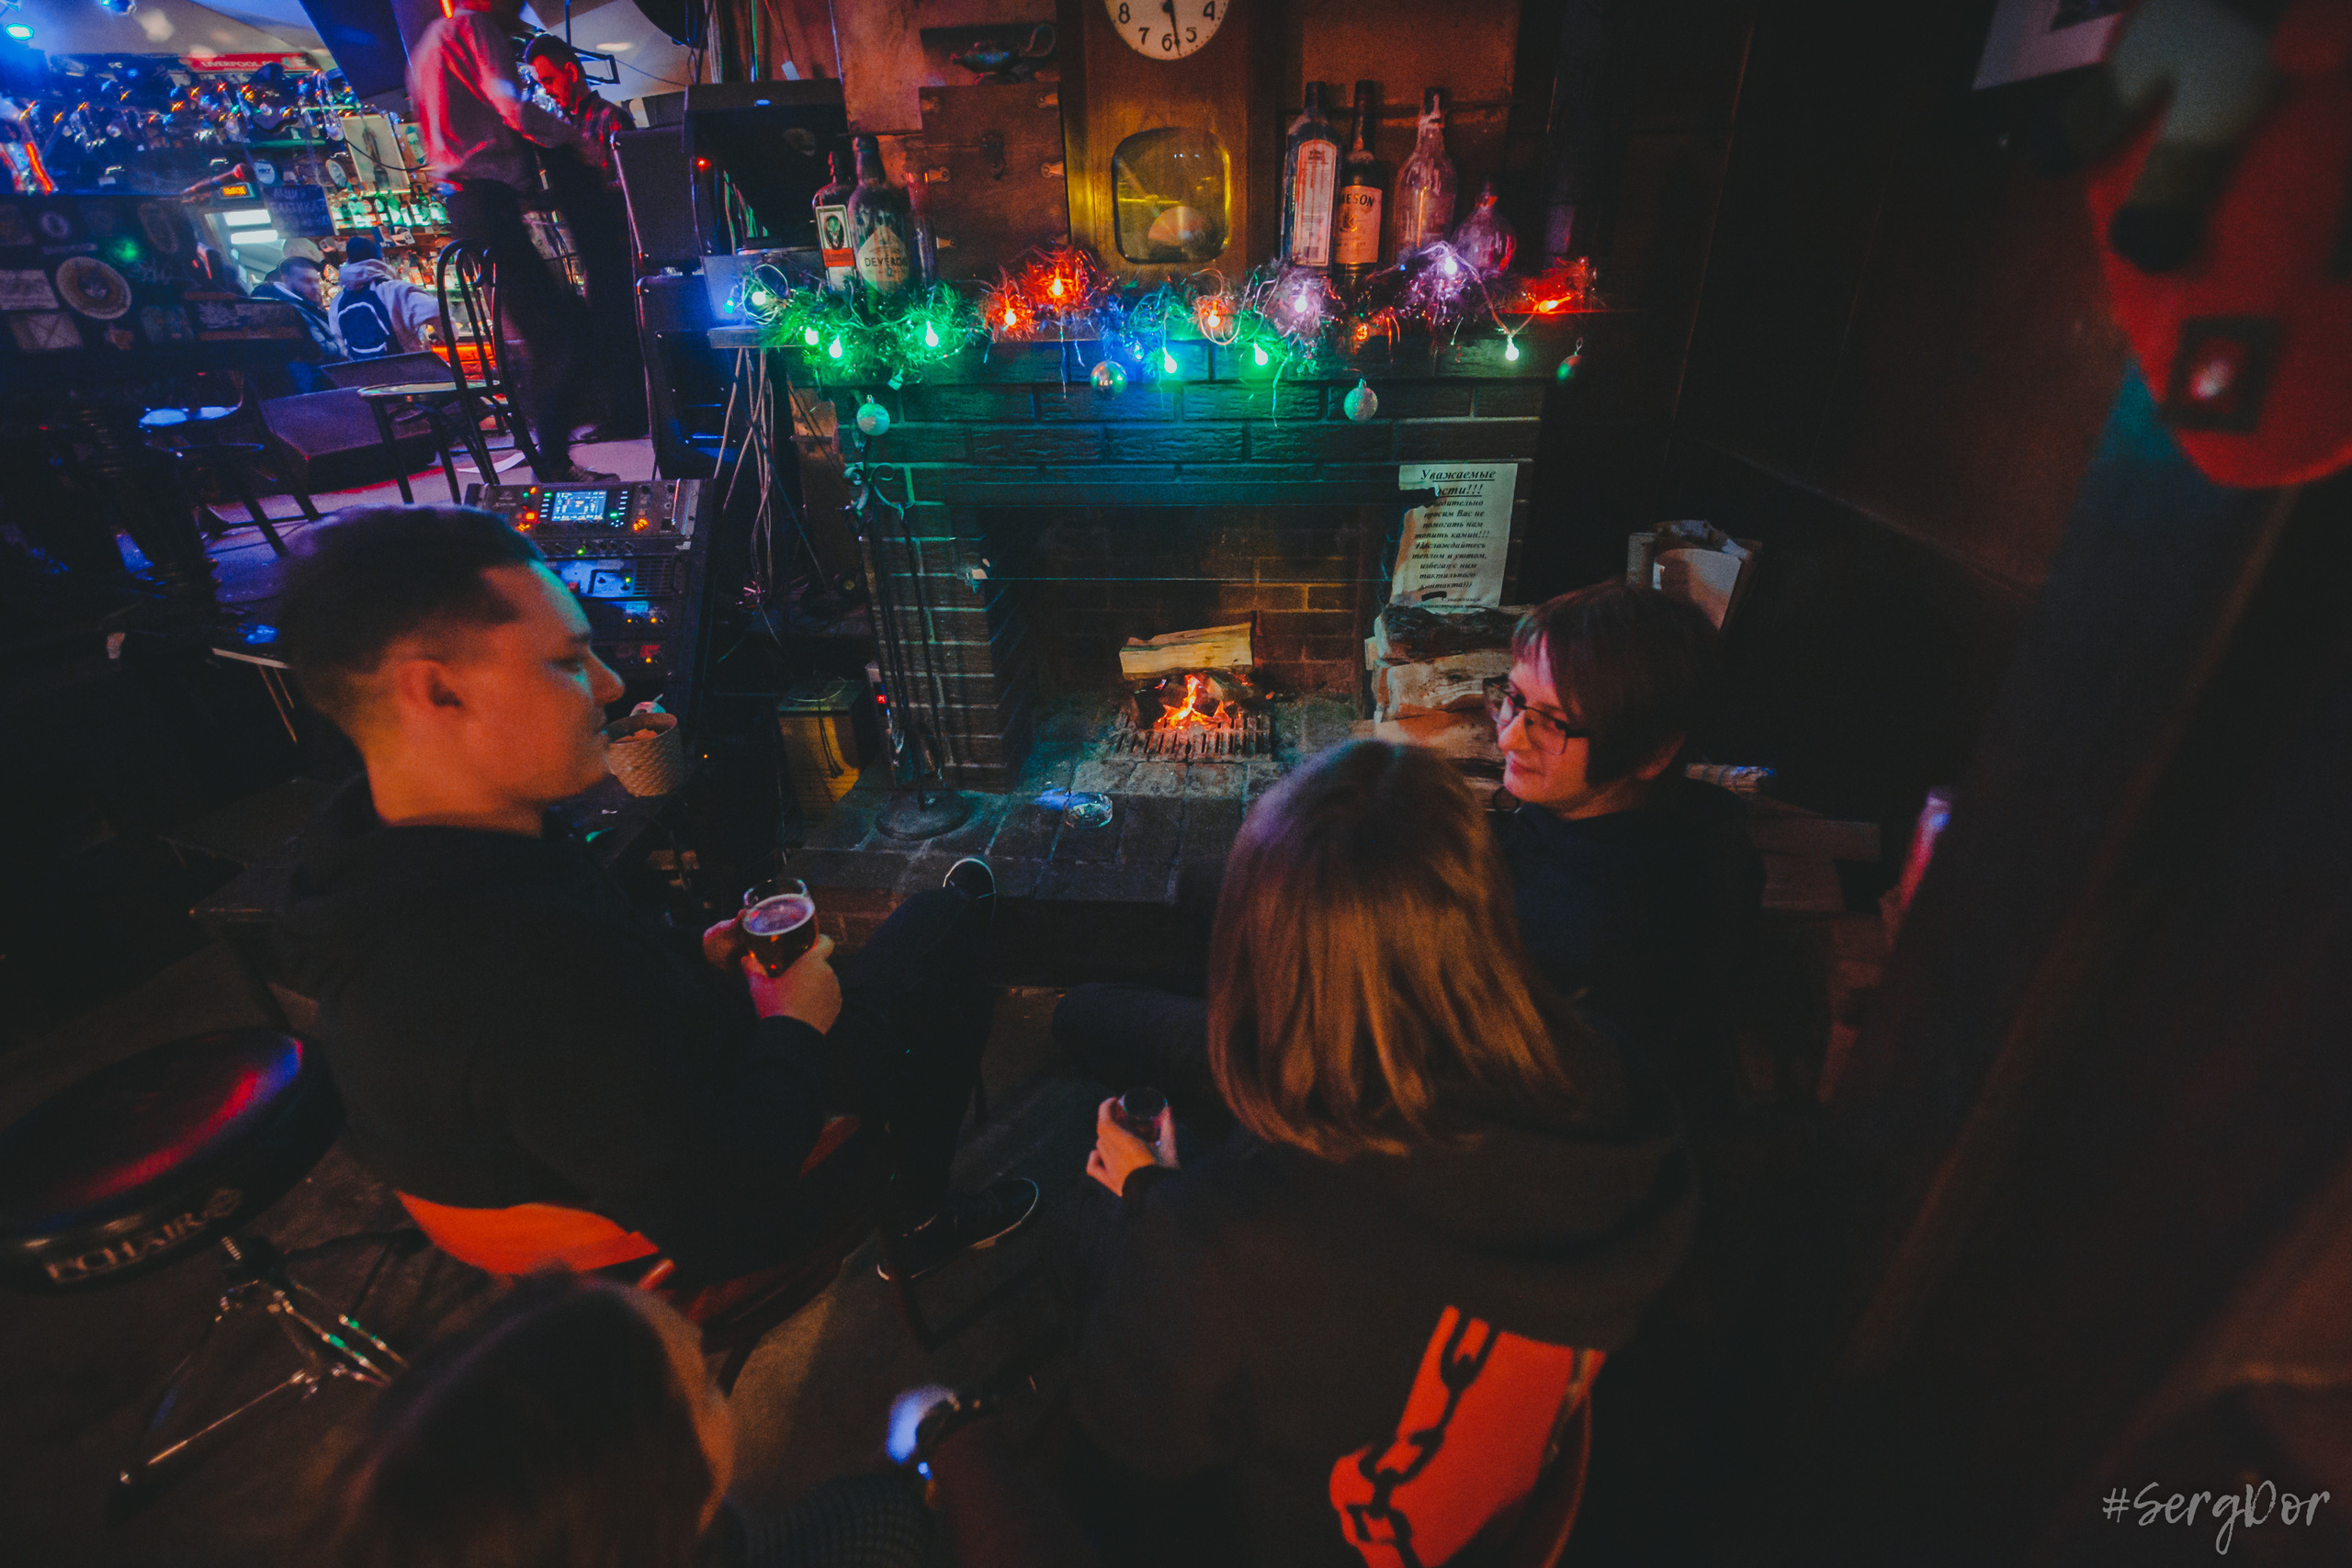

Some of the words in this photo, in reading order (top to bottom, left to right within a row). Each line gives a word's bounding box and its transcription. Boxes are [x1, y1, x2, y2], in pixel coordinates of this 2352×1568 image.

[1118, 2, 1131, 24] 8
[1203, 1, 1216, 21] 4
[1138, 27, 1150, 45] 7
[1161, 33, 1173, 51] 6
[1186, 27, 1197, 43] 5
[1339, 193, 1375, 209] MESON
[1420, 469, 1497, 481] Уважаемые
[1439, 484, 1484, 496] сти!!!
[1451, 530, 1490, 538] камин!!!
